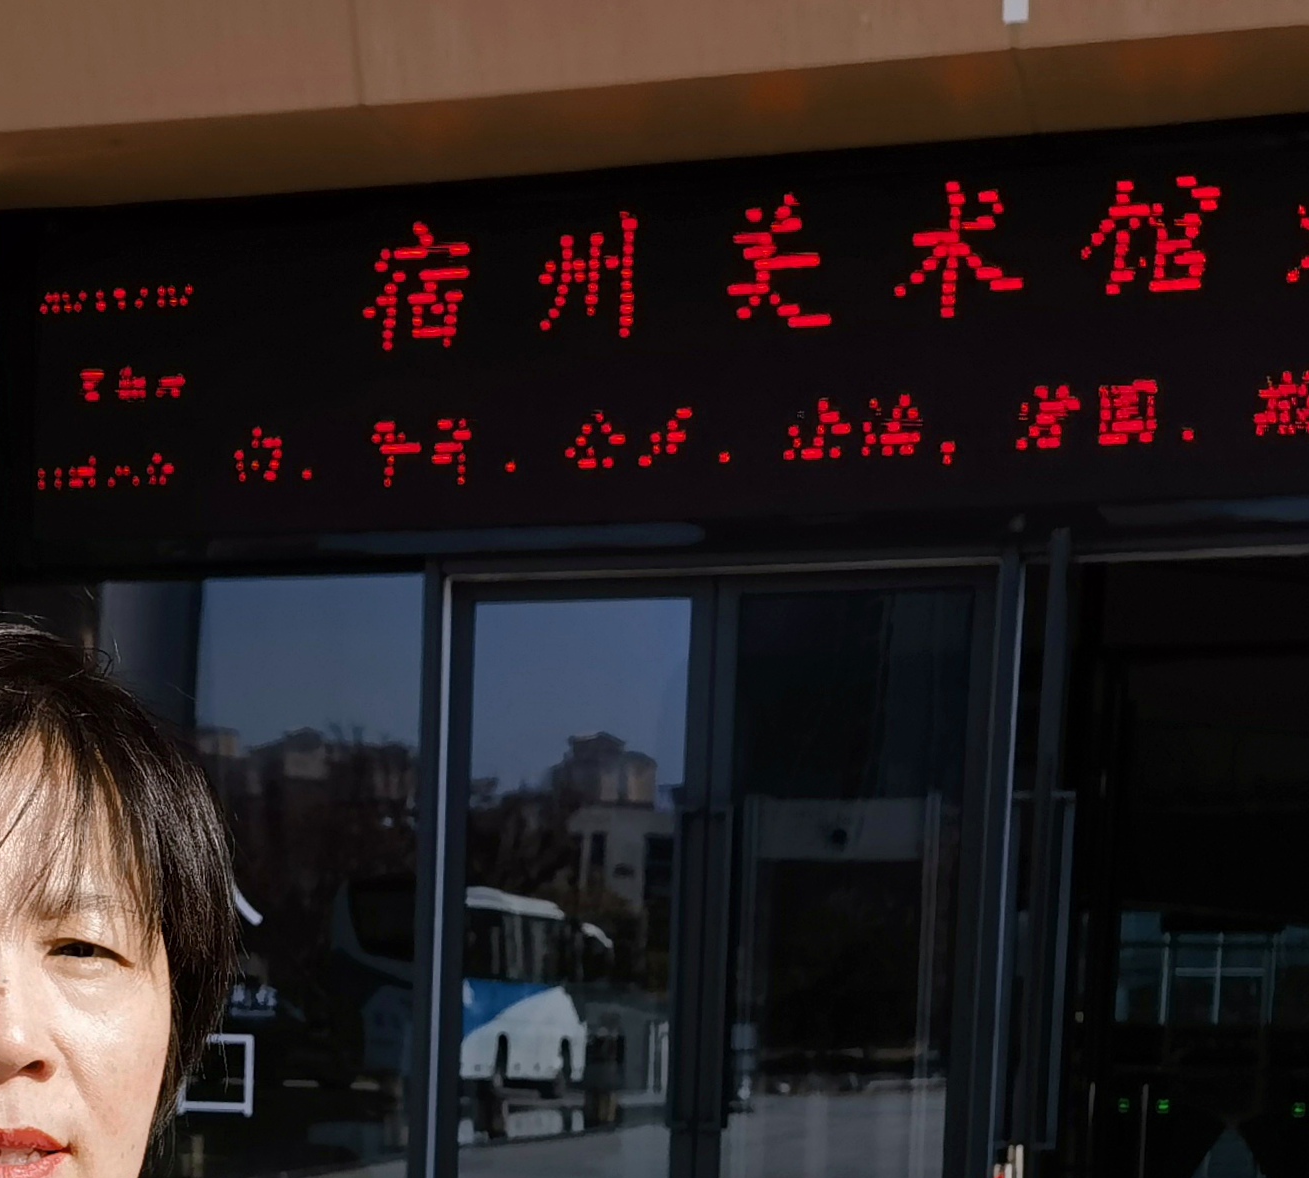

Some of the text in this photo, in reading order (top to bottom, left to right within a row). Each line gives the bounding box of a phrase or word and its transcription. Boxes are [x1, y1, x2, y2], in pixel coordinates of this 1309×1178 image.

[361, 173, 1309, 352] 宿州美术馆
